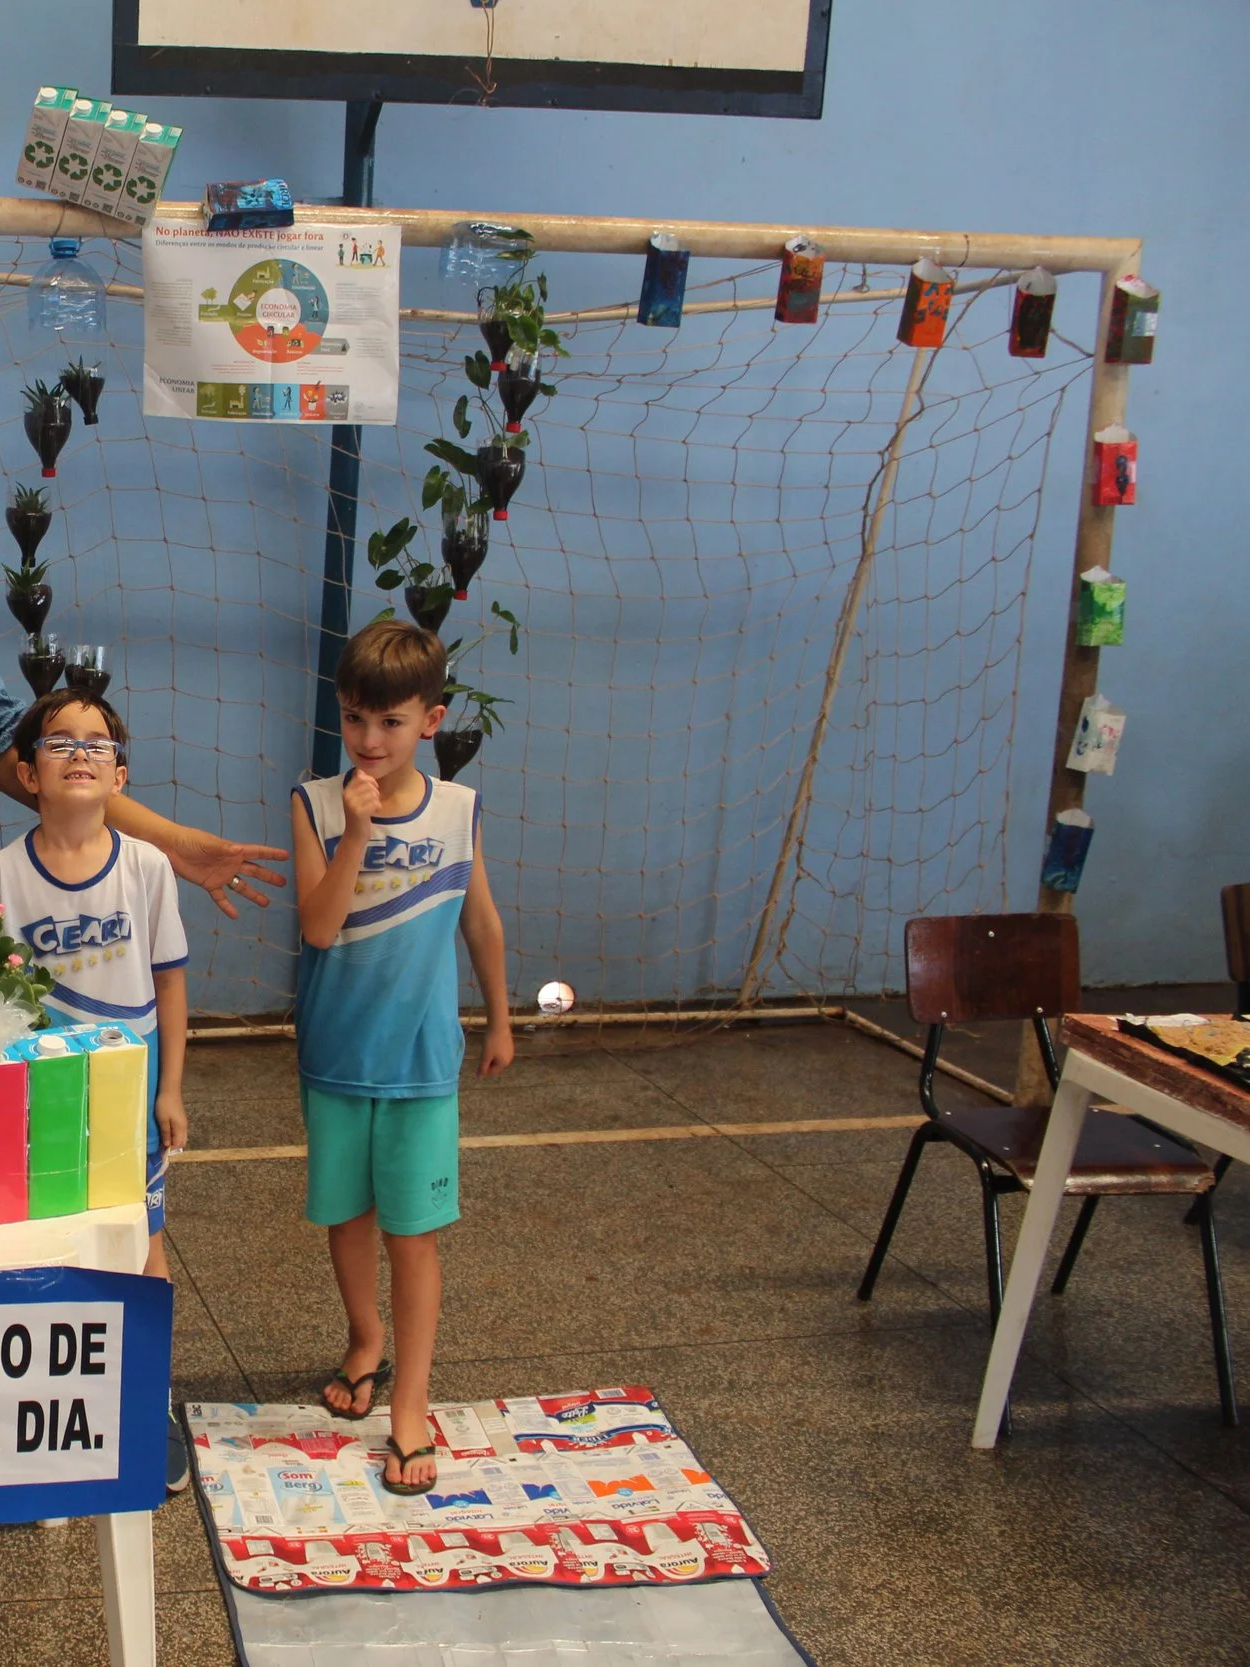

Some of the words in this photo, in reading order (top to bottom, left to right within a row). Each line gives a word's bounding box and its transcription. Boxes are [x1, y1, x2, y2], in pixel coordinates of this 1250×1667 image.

[156, 227, 170, 236] No
[173, 228, 213, 239] planeta,
[242, 229, 275, 240] EXISTE
[277, 231, 301, 242] jogar
[305, 231, 324, 241] fora
[155, 239, 189, 248] Diferenças
[261, 303, 297, 311] ECONOMIA
[159, 377, 195, 387] ECONOMIA
[172, 386, 195, 394] LINEAR
[48, 1323, 107, 1376] DE
[560, 1405, 590, 1421] Leite
[17, 1398, 104, 1452] DIA.
[284, 1481, 320, 1492] Berg
[445, 1513, 494, 1522] Latvida
[509, 1560, 549, 1568] Aurora
[659, 1557, 699, 1569] Aurora
[311, 1568, 350, 1576] Aurora
